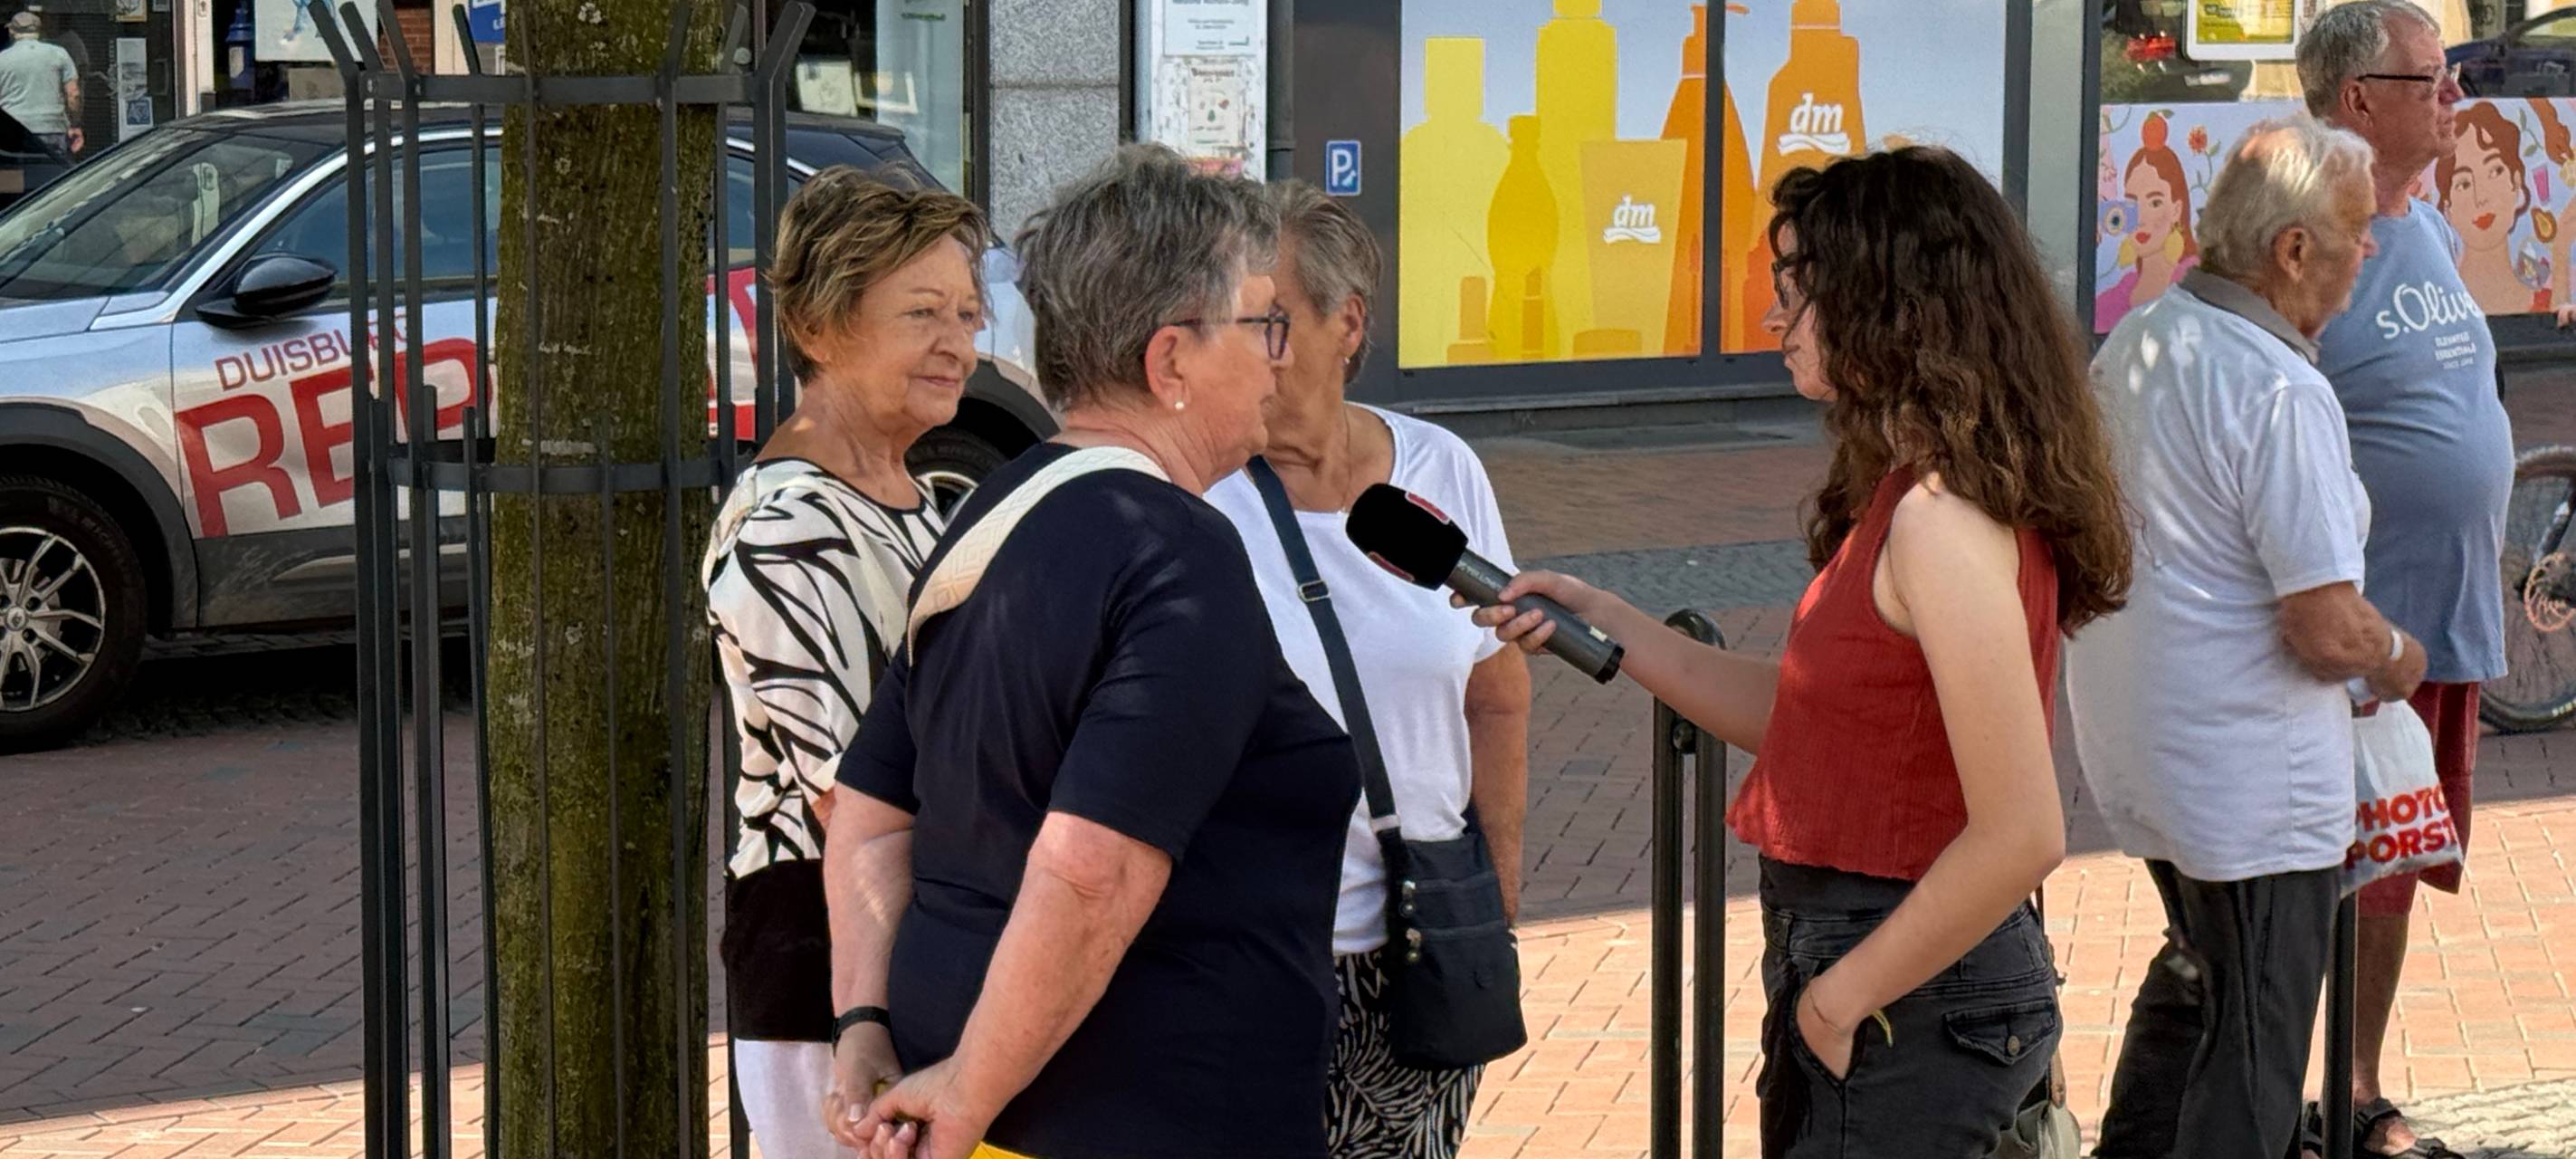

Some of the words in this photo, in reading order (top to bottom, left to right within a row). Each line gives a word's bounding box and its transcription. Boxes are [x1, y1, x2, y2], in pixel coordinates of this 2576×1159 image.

[1790, 92, 1844, 133] dm
[1332, 149, 1352, 187] P
[1613, 195, 1655, 226] dm
[2375, 280, 2485, 340] s.Olive
